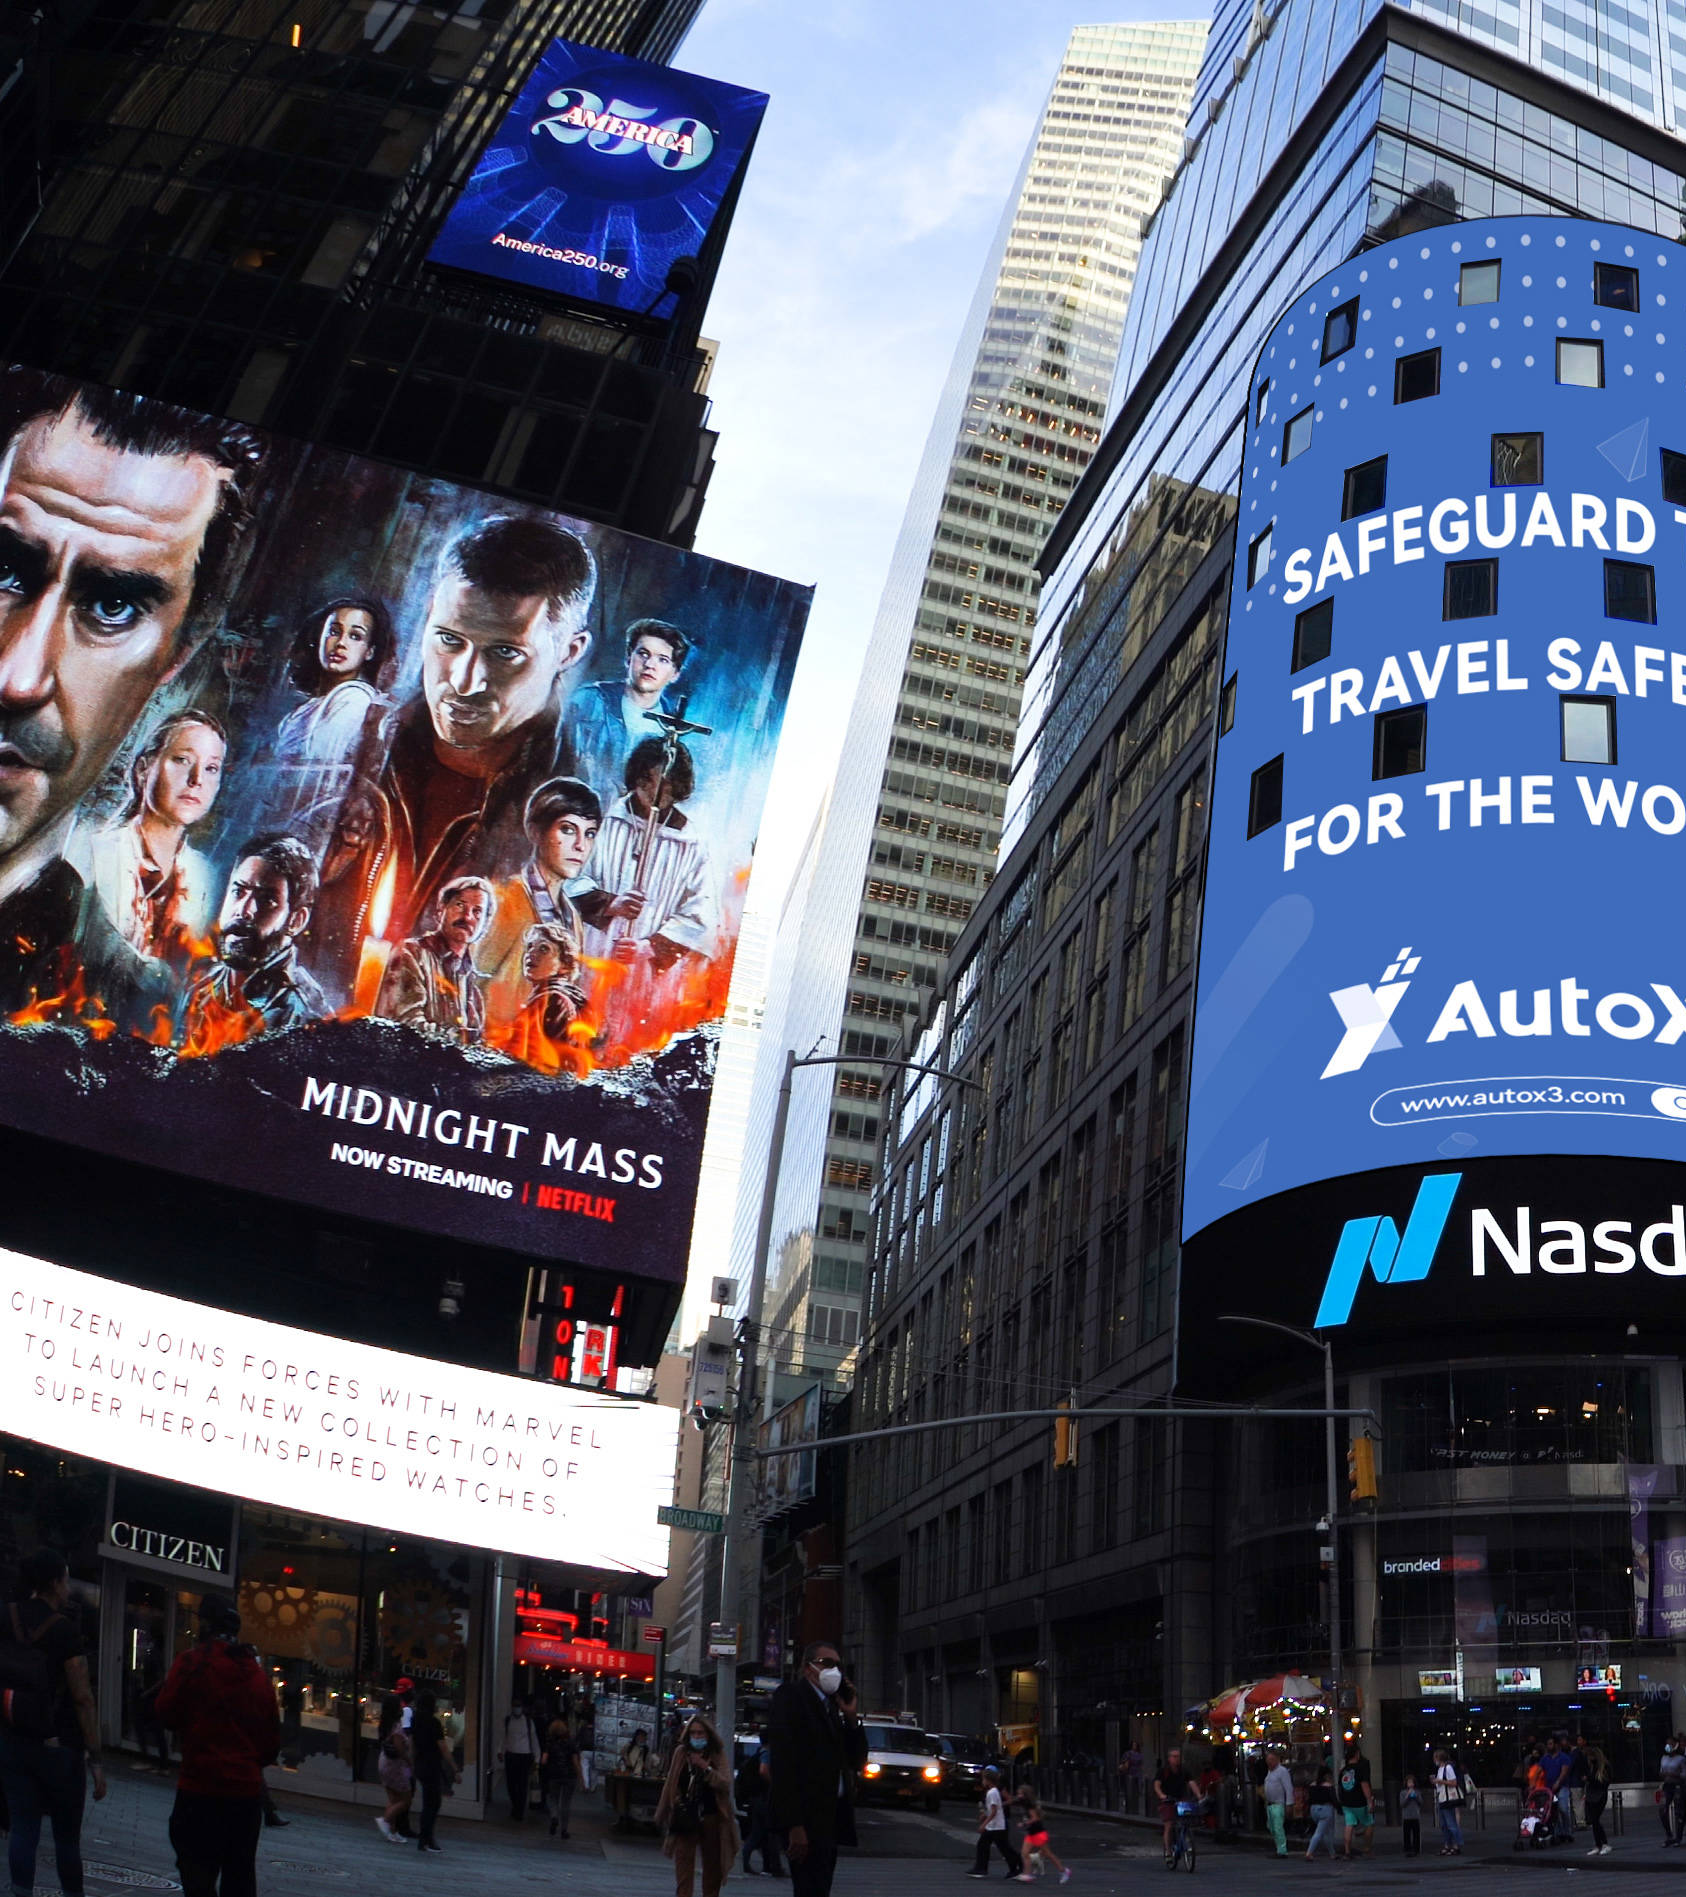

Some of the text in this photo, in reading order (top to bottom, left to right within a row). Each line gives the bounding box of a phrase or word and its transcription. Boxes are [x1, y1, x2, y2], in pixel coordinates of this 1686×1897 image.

[531, 88, 714, 171] 250
[560, 105, 693, 155] AMERICA
[491, 232, 630, 280] America250.org
[1282, 492, 1657, 605] SAFEGUARD
[1291, 638, 1529, 735] TRAVEL
[1283, 792, 1406, 872] FOR
[1425, 775, 1555, 830] THE
[300, 1077, 664, 1190] MIDNIGHT MASS
[1401, 1087, 1626, 1113] www.autox3.com
[330, 1142, 617, 1223] NOW STREAMING NETFLIX
[11, 1291, 603, 1450] CITIZEN JOINS FORCES WITH MARVEL
[25, 1333, 579, 1481] TO LAUNCH A NEW COLLECTION OF
[34, 1375, 568, 1519] SUPER HERO-INSPIRED WATCHES.
[110, 1520, 225, 1571] CITIZEN
[659, 1508, 720, 1532] BROADWAY
[576, 1650, 626, 1669] DINER
[1507, 1608, 1572, 1632] Nasdaq
